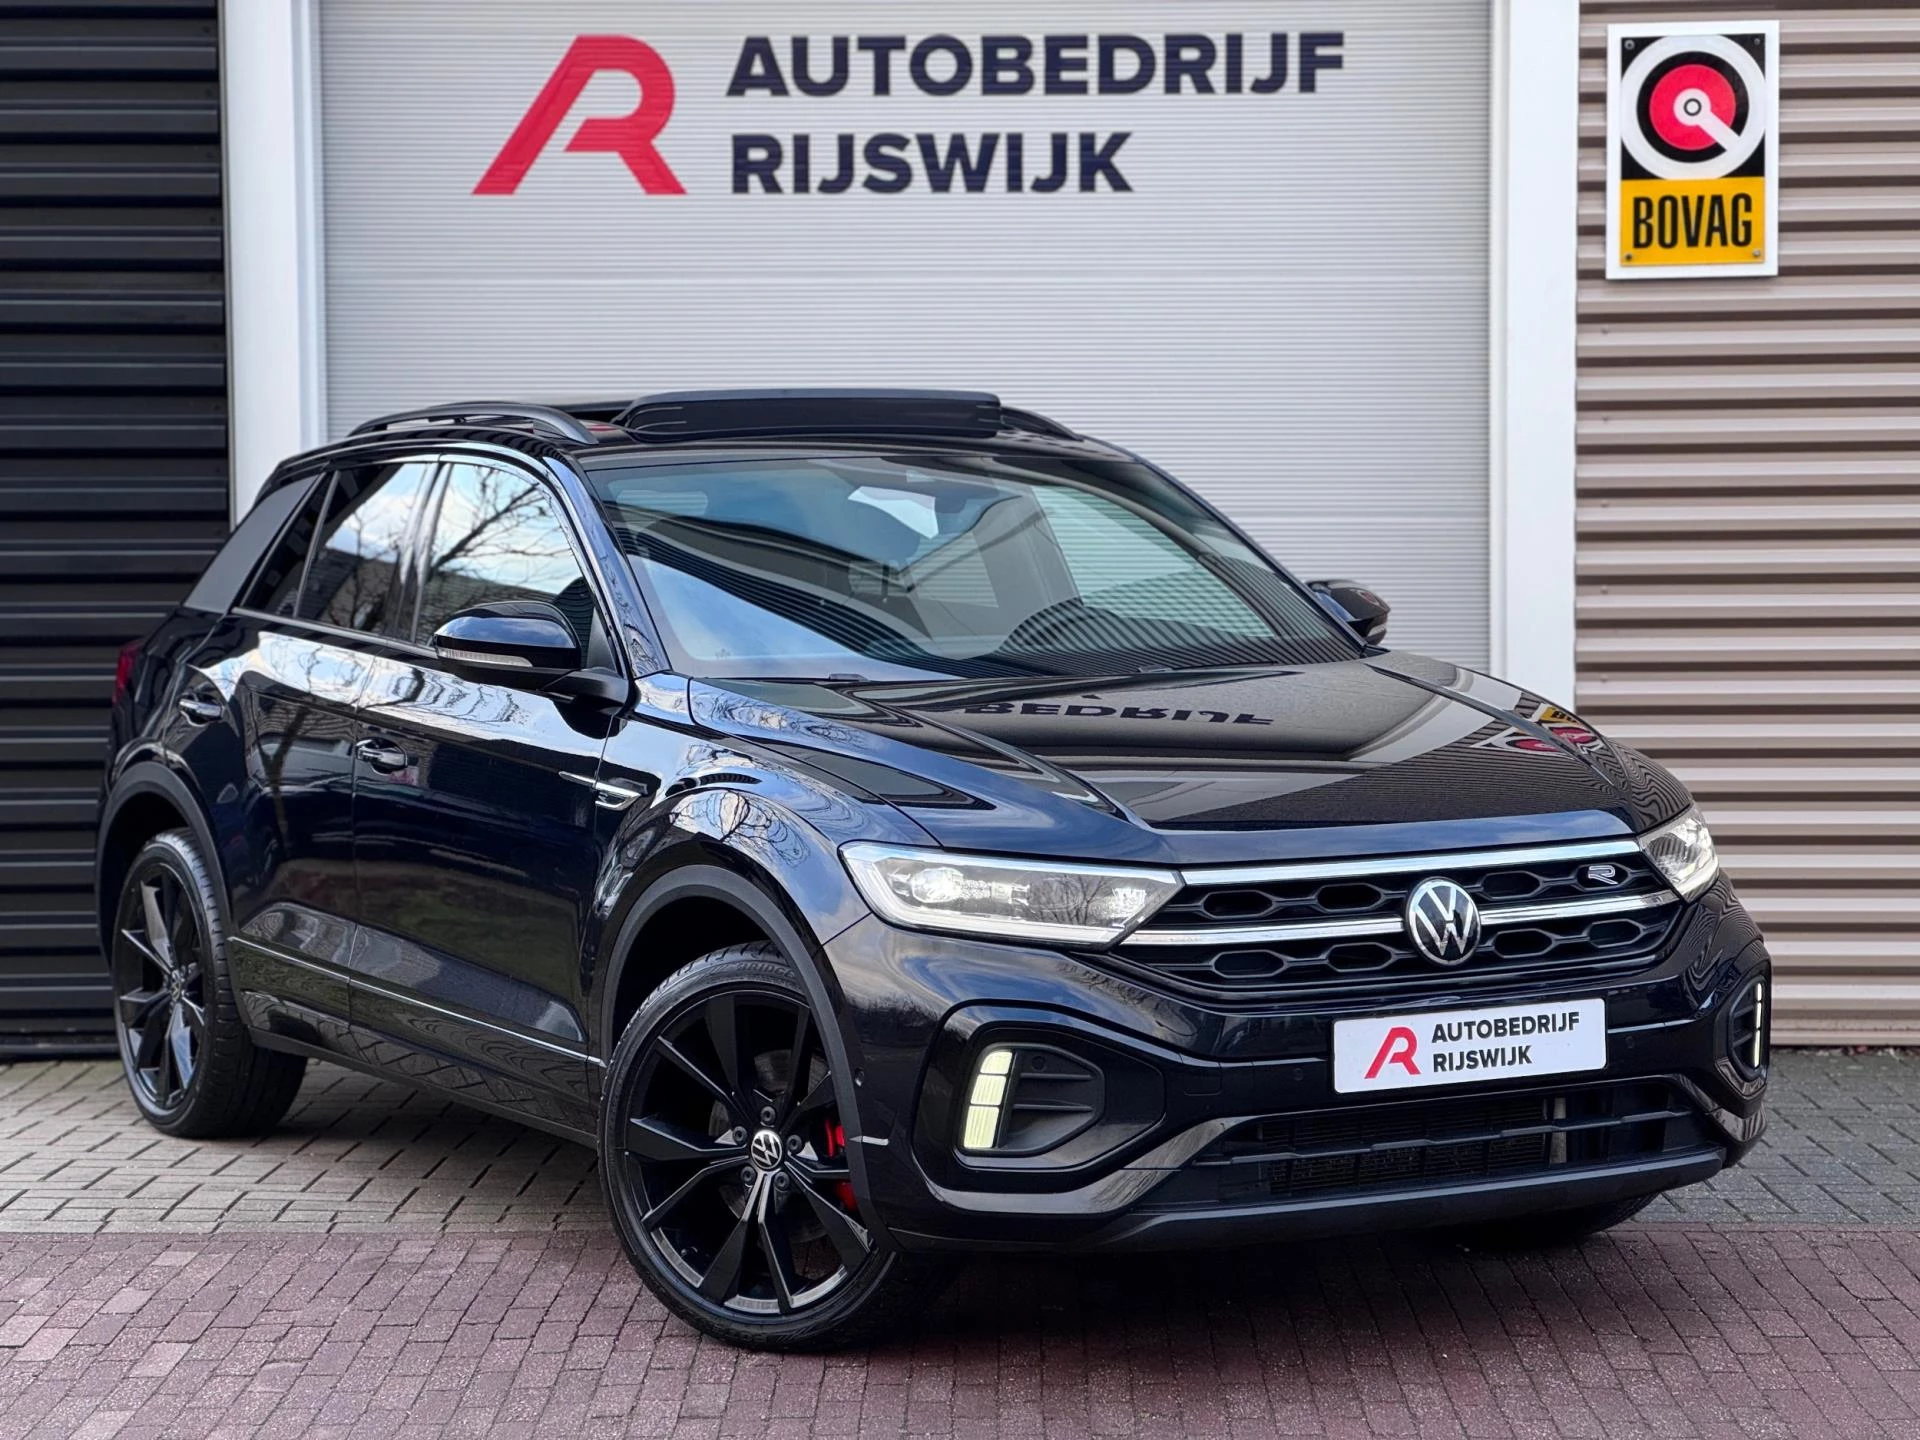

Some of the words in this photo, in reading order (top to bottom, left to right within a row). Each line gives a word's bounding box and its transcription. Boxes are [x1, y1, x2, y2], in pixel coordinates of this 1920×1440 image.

[727, 32, 1344, 97] AUTOBEDRIJF
[732, 132, 1133, 194] RIJSWIJK
[1633, 192, 1752, 249] BOVAG
[1431, 1011, 1580, 1043] AUTOBEDRIJF
[1433, 1045, 1533, 1072] RIJSWIJK
